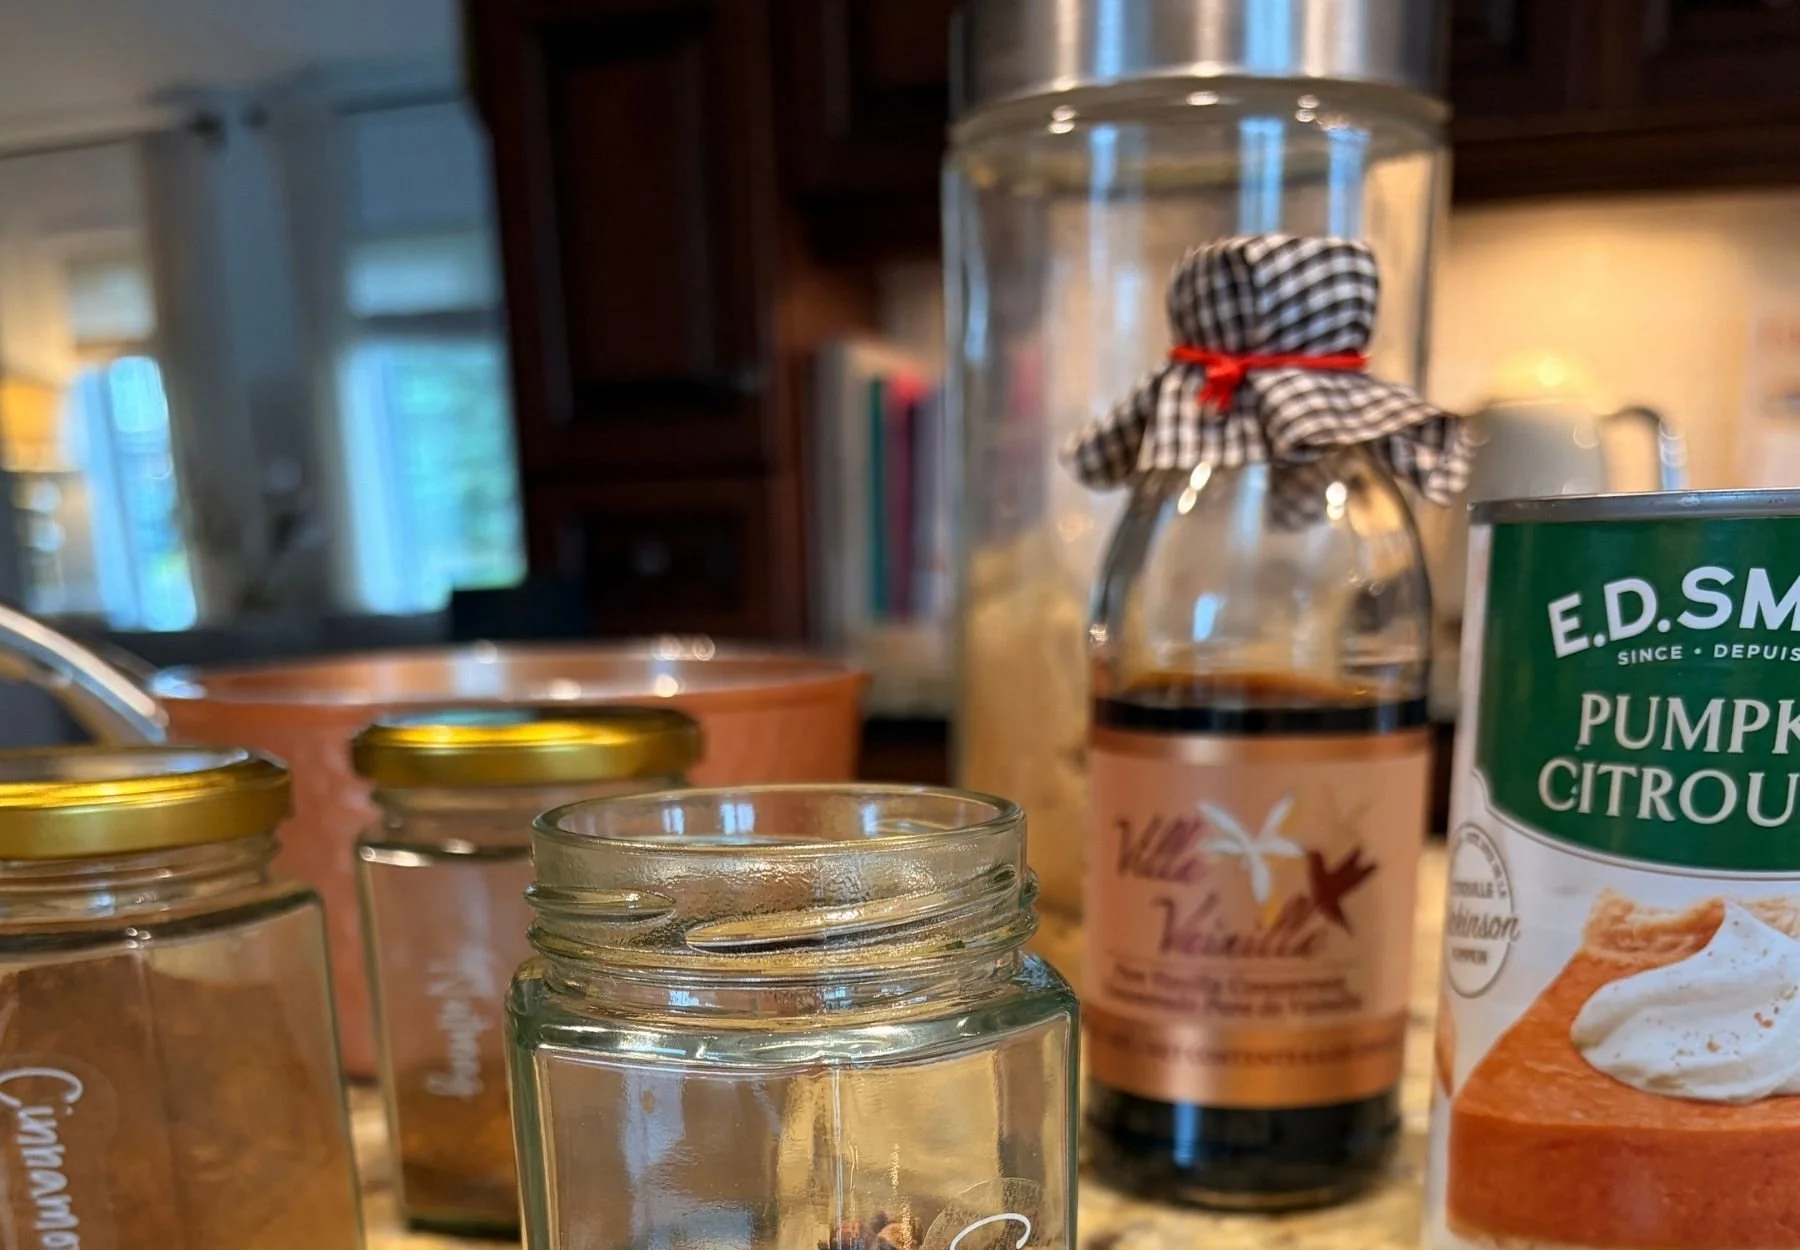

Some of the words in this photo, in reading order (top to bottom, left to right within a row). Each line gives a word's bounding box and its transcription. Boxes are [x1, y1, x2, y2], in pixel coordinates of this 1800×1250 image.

[1616, 644, 1685, 667] SINCE
[1712, 643, 1800, 662] DEPUIS
[1576, 692, 1800, 755] PUMPK
[1537, 757, 1800, 828] CITROU
